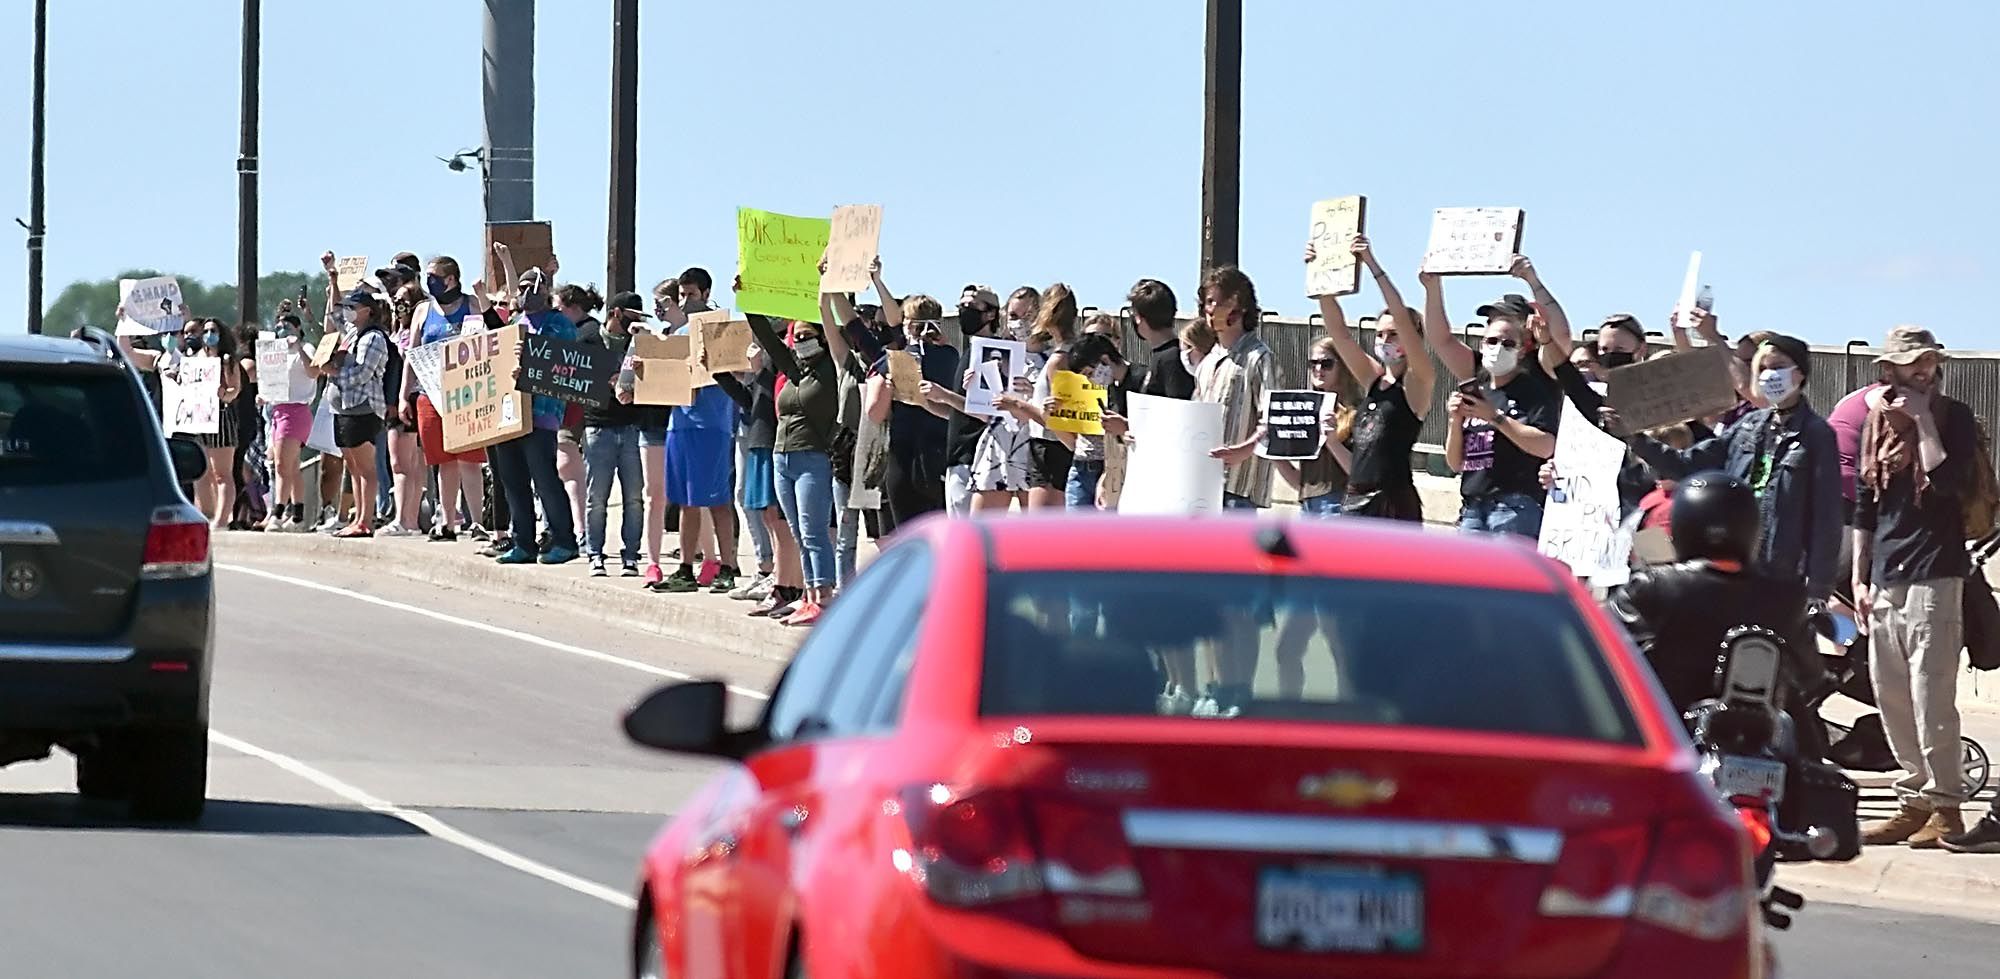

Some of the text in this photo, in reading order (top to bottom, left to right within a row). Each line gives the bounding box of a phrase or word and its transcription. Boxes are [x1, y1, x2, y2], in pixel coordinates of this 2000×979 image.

[445, 331, 500, 372] LOVE
[528, 338, 593, 370] WE WILL
[528, 367, 593, 393] BE SILENT
[551, 363, 577, 379] NOT
[446, 374, 497, 414] HOPE
[467, 415, 492, 437] HATE
[1079, 411, 1101, 422] LIVES
